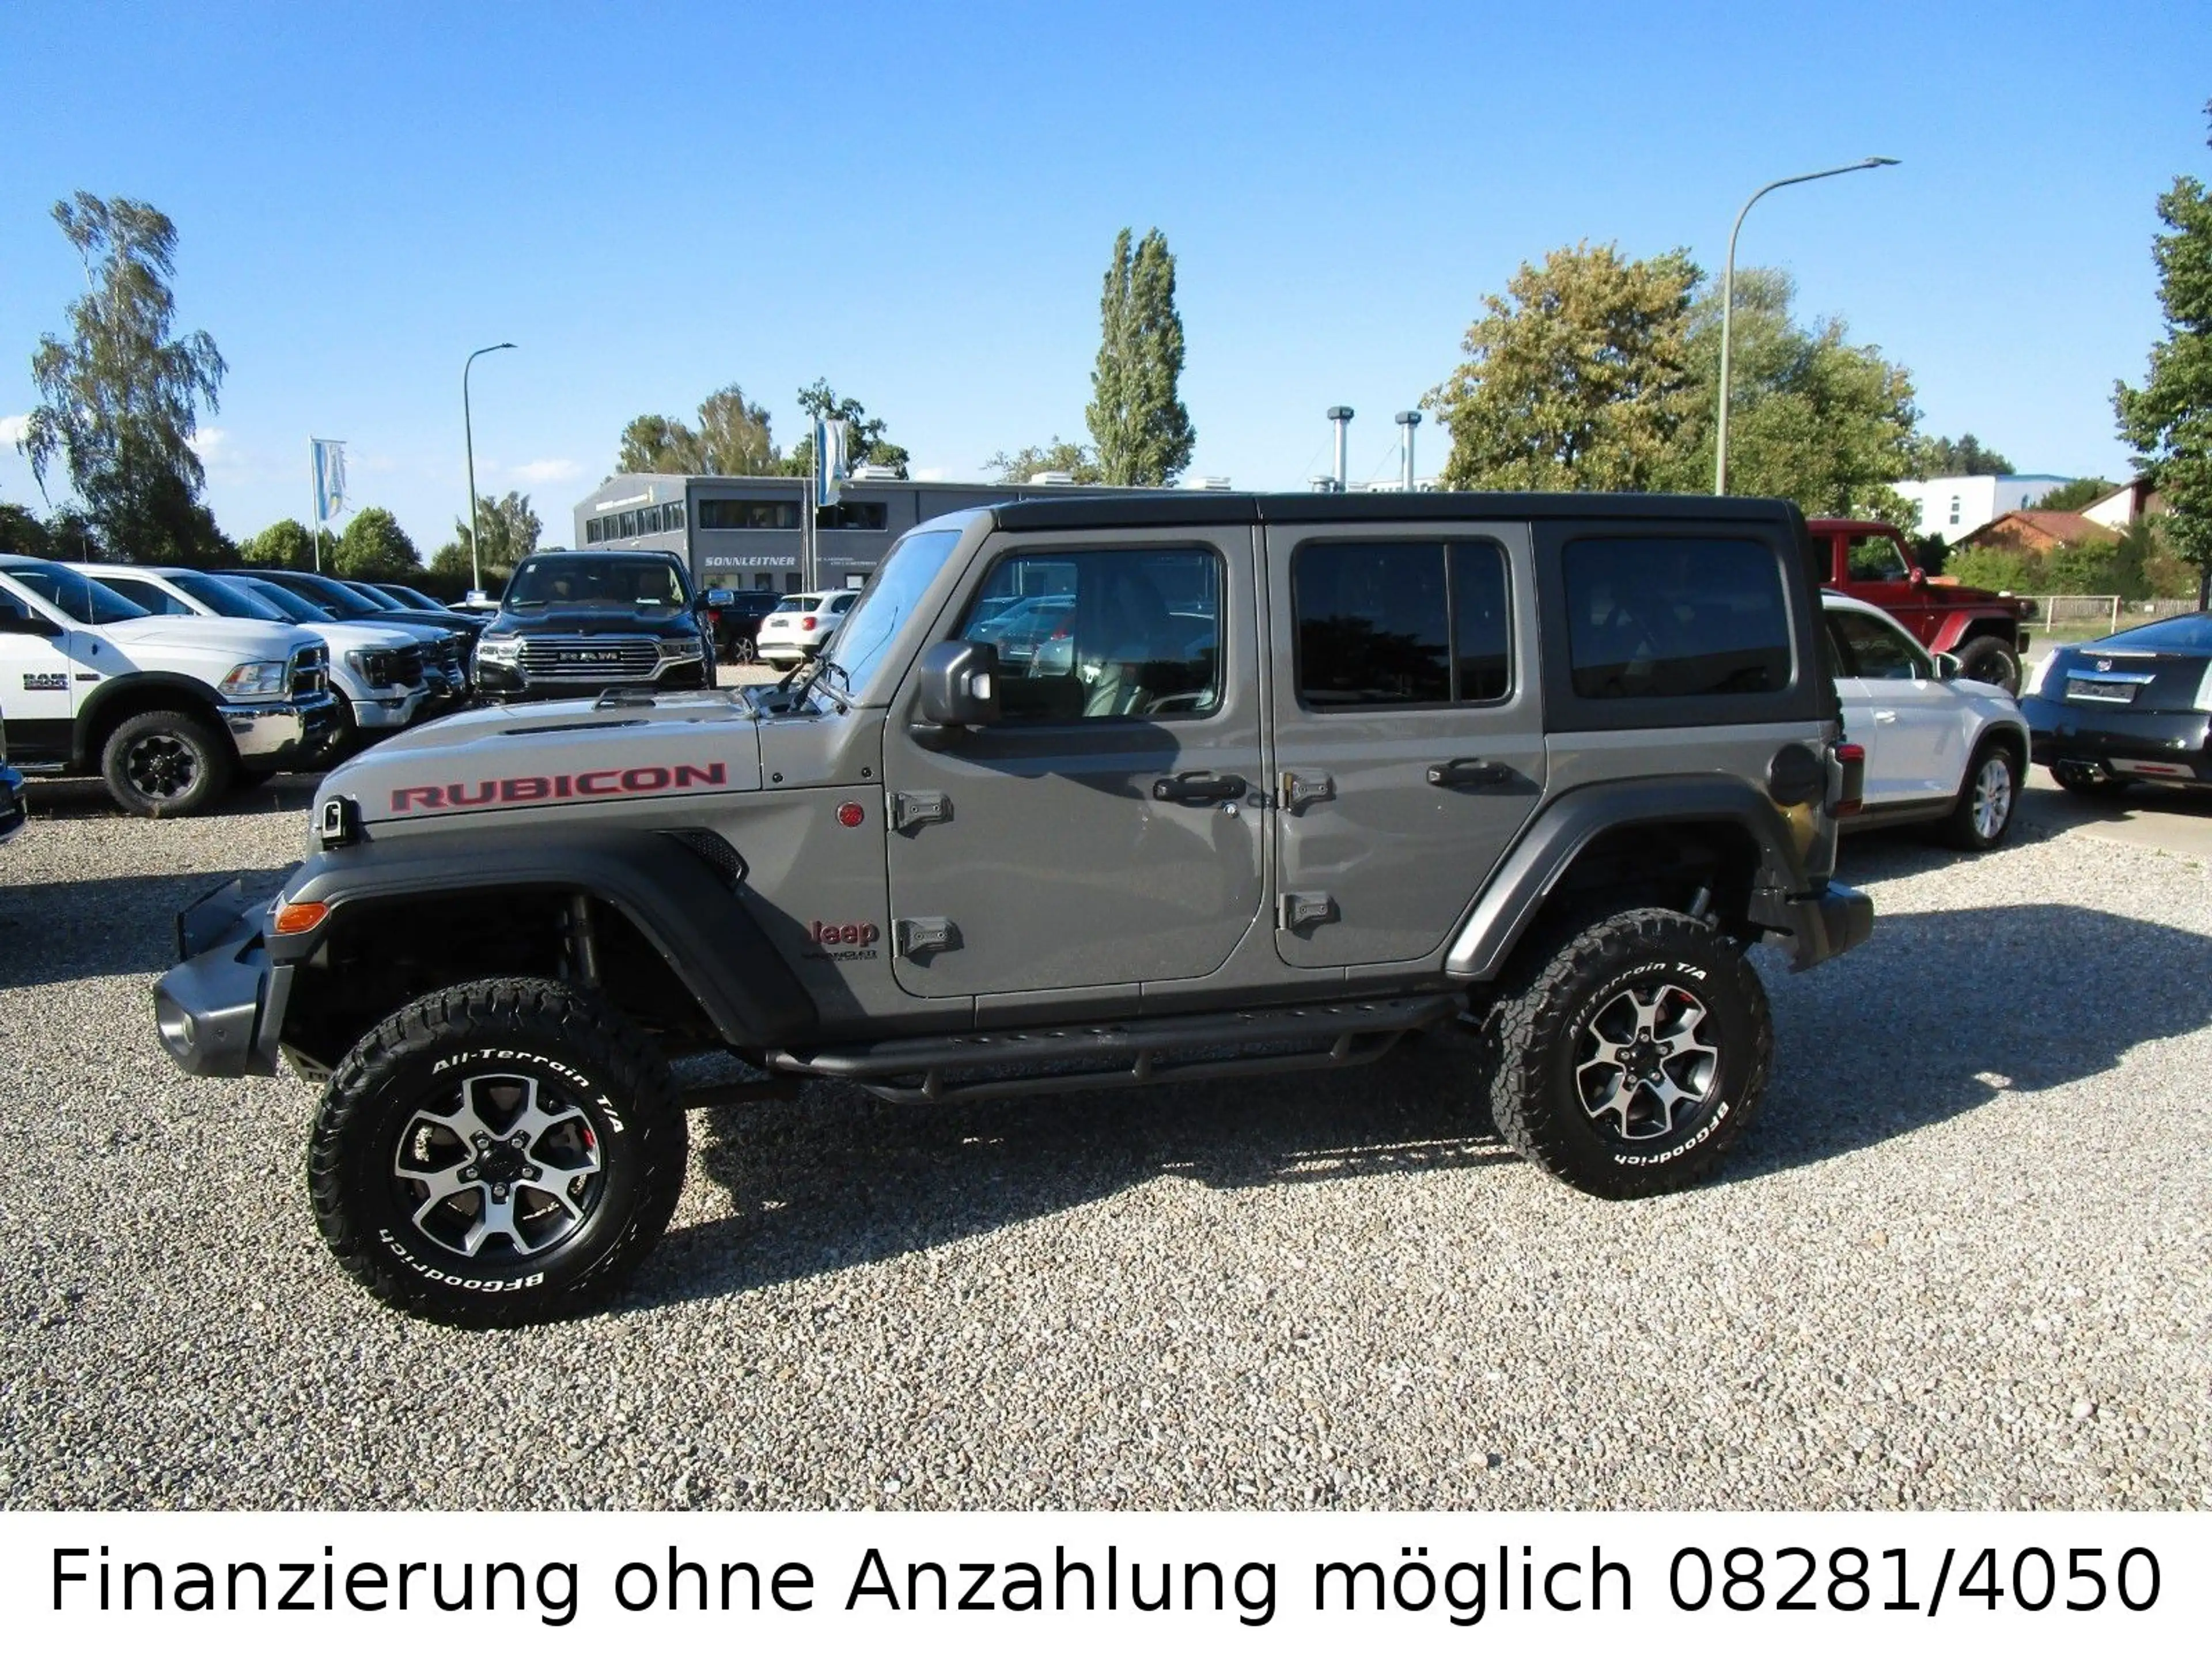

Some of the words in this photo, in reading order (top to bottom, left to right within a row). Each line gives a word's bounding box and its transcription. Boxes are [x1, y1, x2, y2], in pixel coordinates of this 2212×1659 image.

[704, 556, 795, 567] SONNLEITNER
[560, 652, 618, 661] RAM
[391, 762, 726, 812] RUBICON
[809, 920, 880, 948] Jeep
[1676, 962, 1707, 980] T/A
[431, 1048, 590, 1088] All-Terrain
[597, 1094, 624, 1134] T/A
[1614, 1101, 1729, 1167] BFGoodrich
[378, 1228, 545, 1293] BFGoodrich
